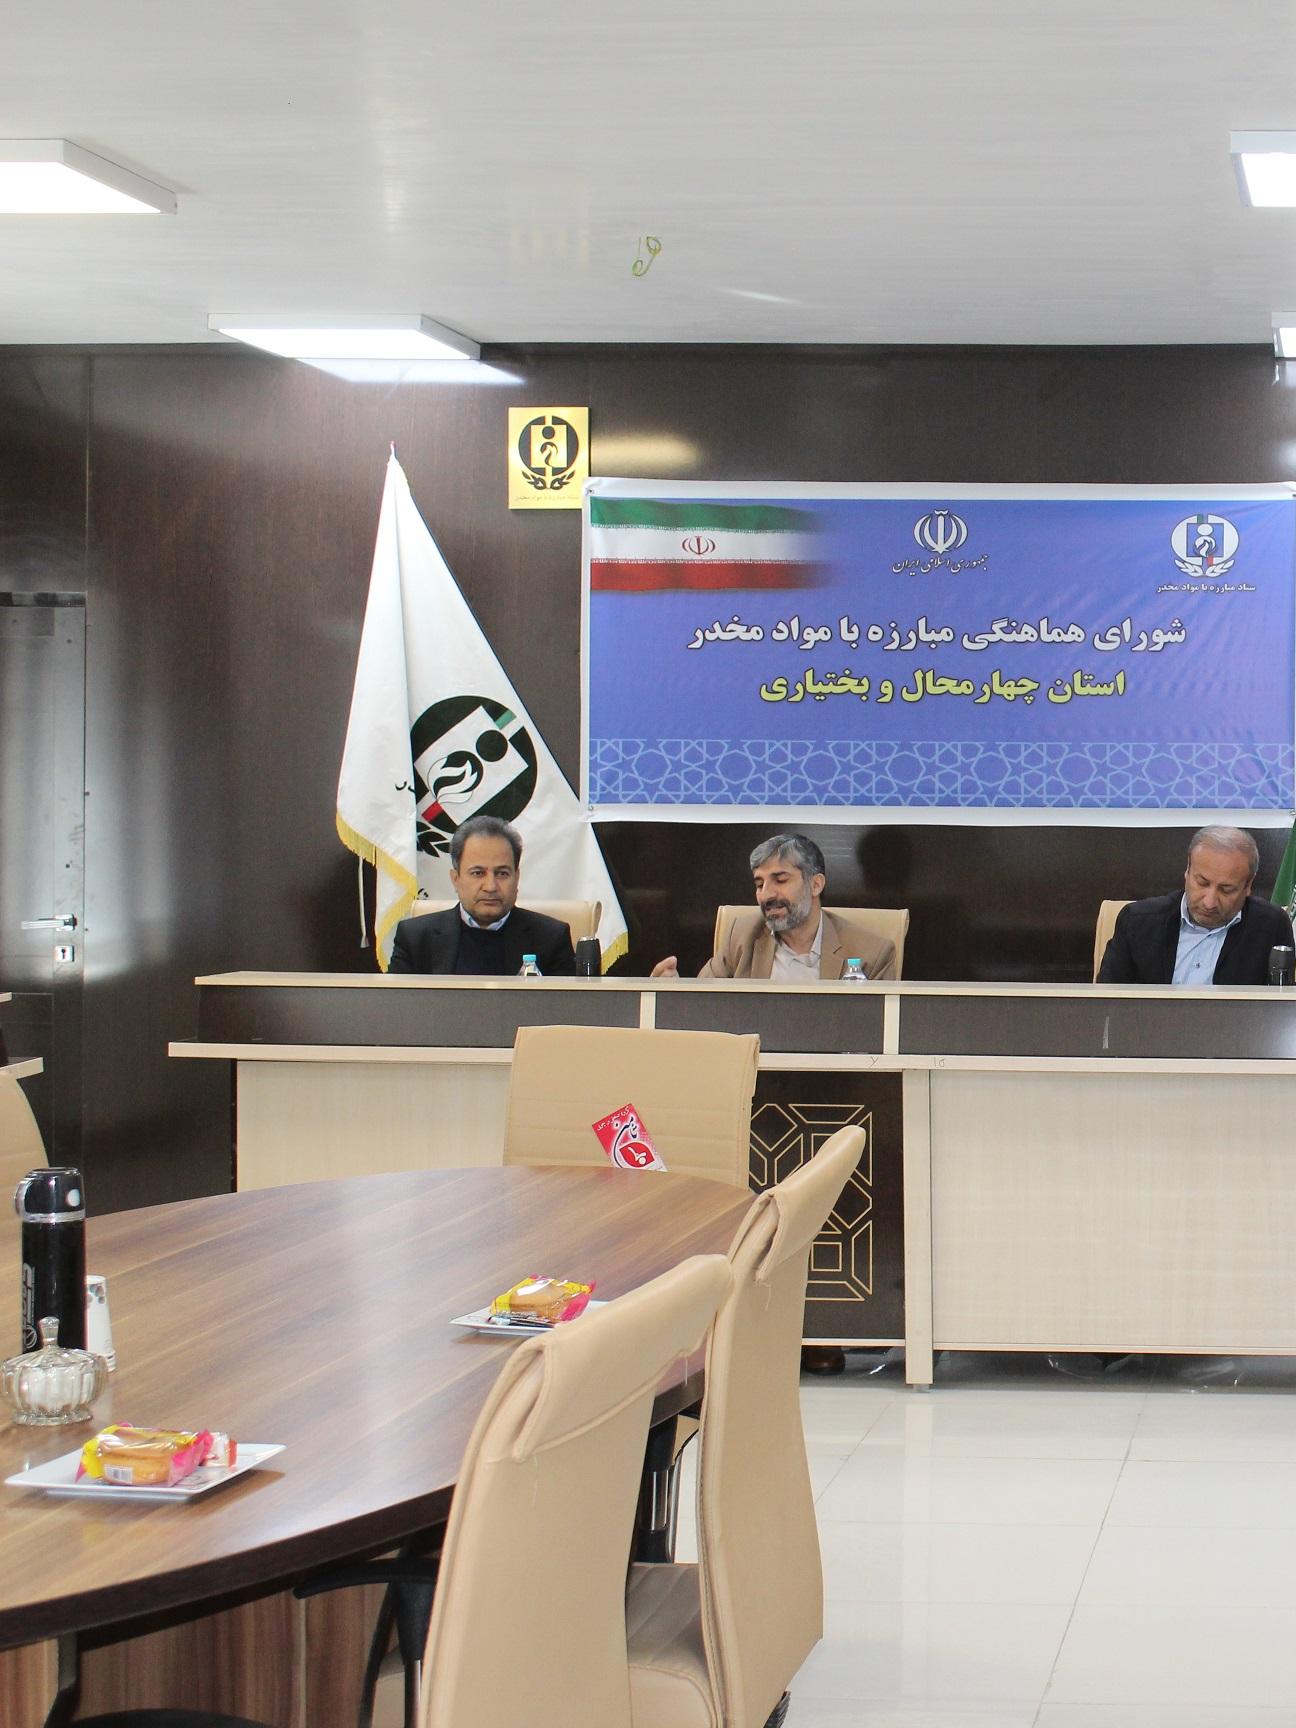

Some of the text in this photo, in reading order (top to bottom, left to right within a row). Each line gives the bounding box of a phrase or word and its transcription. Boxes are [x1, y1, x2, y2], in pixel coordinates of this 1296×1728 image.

[892, 554, 990, 576] جمهوری اسلامی ایران
[1157, 583, 1179, 593] مخدر
[1181, 583, 1200, 593] مواد
[687, 614, 1187, 651] شورای هماهنگی مبارزه با مواد مخدر
[759, 667, 870, 702] بختیاری
[876, 679, 895, 702] و
[1047, 670, 1126, 703] استان
